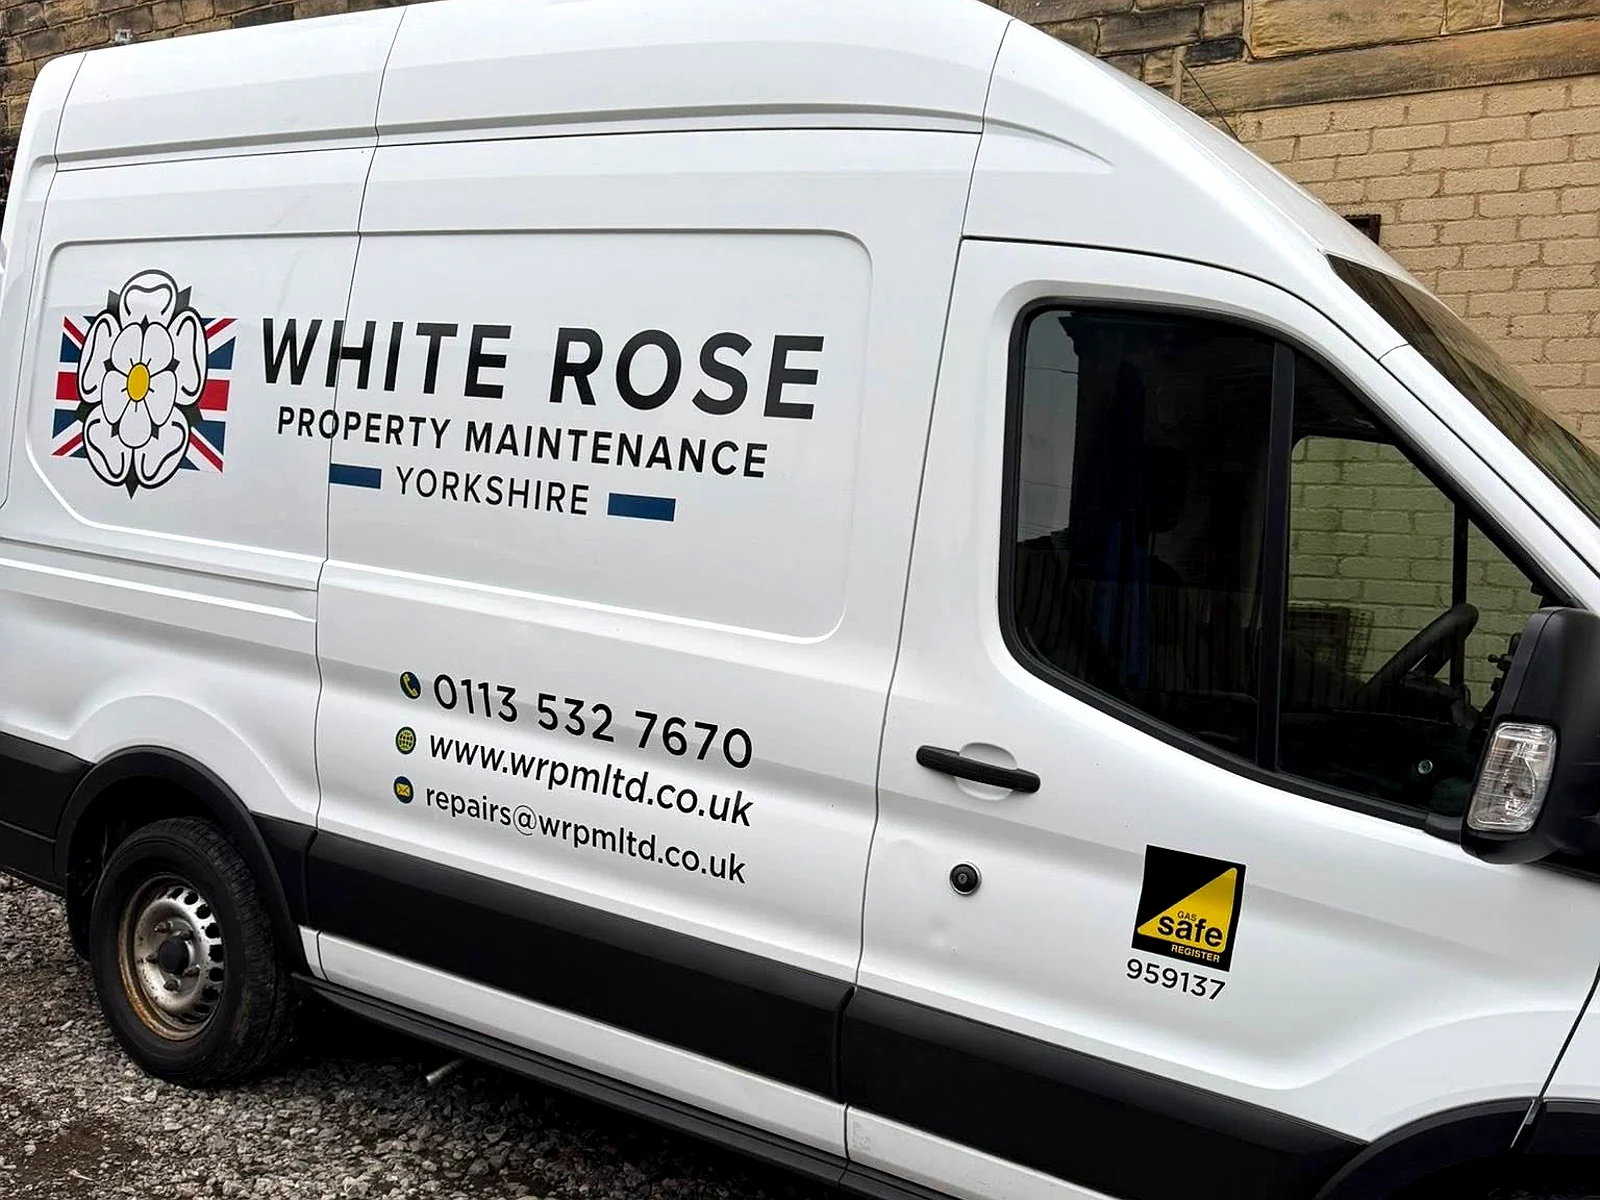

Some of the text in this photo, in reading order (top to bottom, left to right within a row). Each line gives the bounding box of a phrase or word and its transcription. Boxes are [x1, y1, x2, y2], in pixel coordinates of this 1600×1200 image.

[262, 317, 825, 420] WHITE ROSE
[277, 405, 768, 479] PROPERTY MAINTENANCE
[395, 466, 590, 516] YORKSHIRE
[433, 673, 753, 769] 0113 532 7670
[429, 733, 754, 827] www.wrpmltd.co.uk
[425, 786, 747, 884] repairs@wrpmltd.co.uk
[1157, 916, 1223, 947] safe
[1177, 910, 1197, 922] GAS
[1126, 958, 1226, 1000] 959137
[1171, 944, 1220, 963] REGISTER
